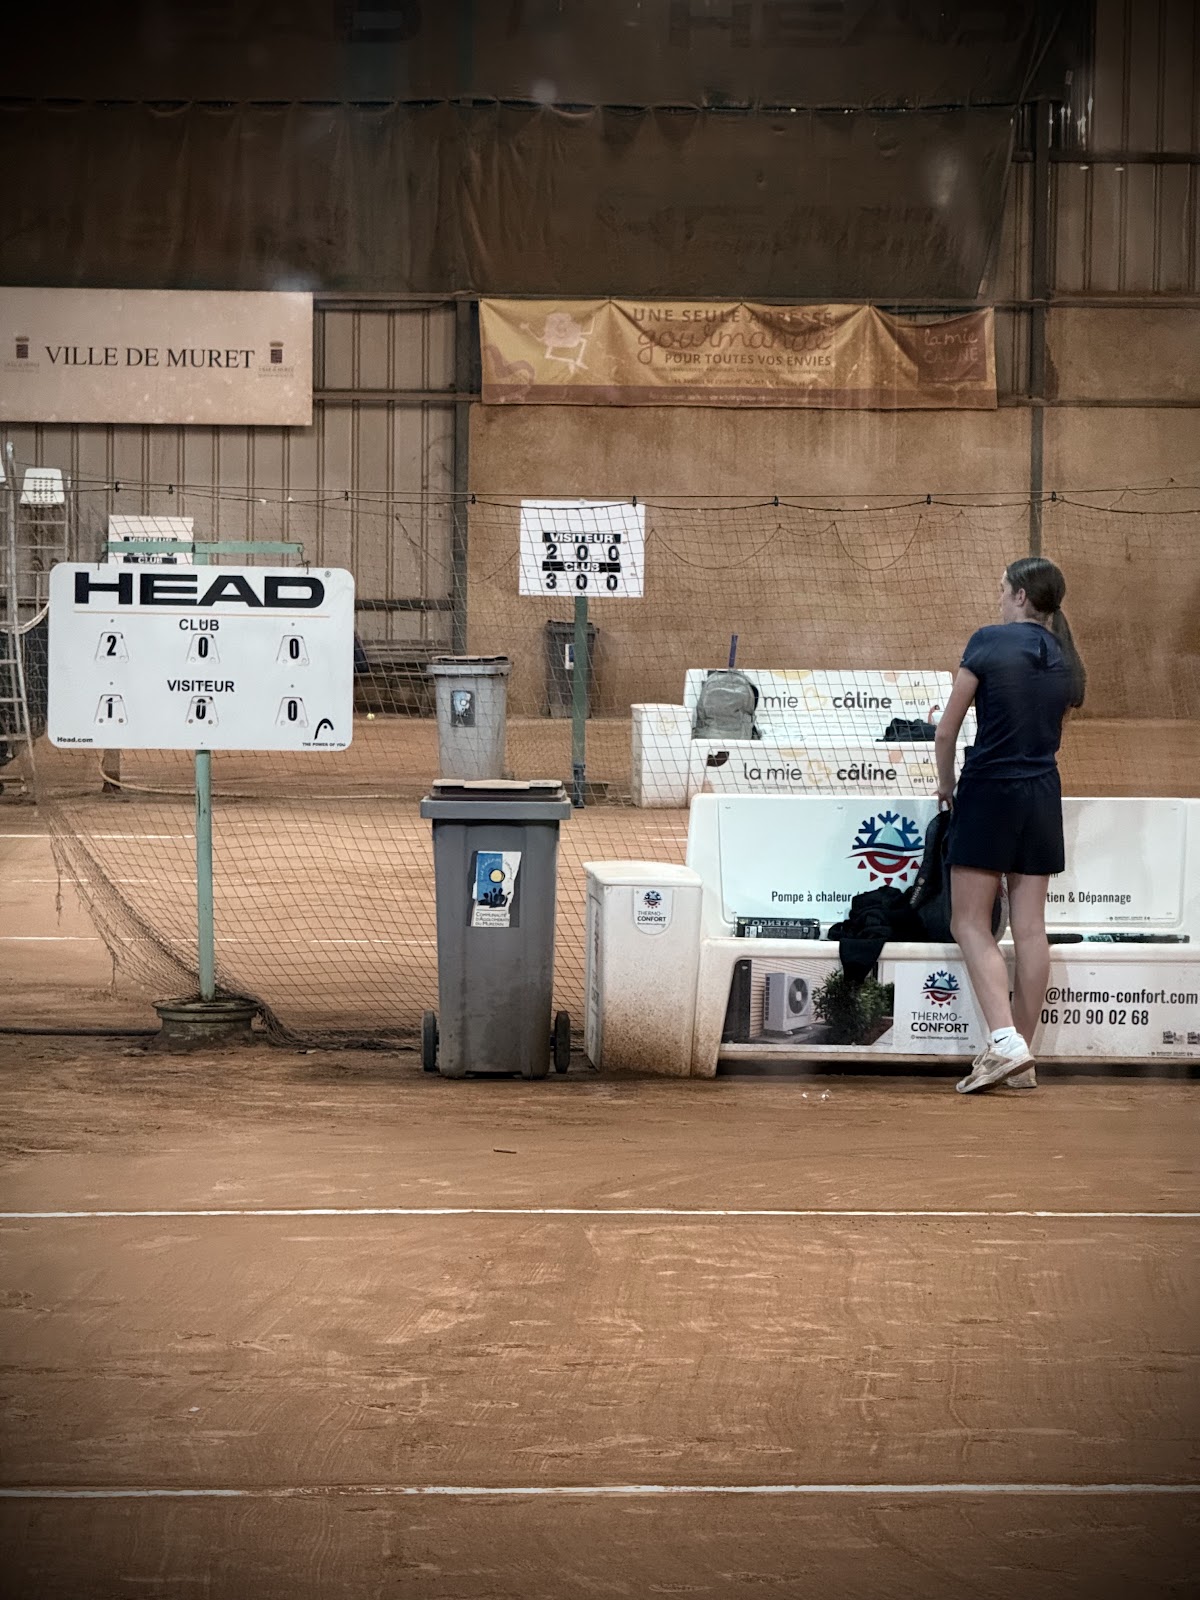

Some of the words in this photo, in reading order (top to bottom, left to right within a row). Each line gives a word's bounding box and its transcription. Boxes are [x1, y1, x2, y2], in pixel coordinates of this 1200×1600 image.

[633, 307, 674, 323] UNE
[682, 309, 740, 324] SEULE
[44, 345, 119, 366] VILLE
[126, 347, 160, 368] DE
[166, 348, 256, 370] MURET
[665, 353, 701, 364] POUR
[704, 353, 754, 365] TOUTES
[757, 354, 783, 366] VOS
[786, 355, 832, 367] ENVIES
[549, 533, 614, 543] VISITEUR
[546, 543, 558, 560] 2
[576, 545, 589, 561] 0
[608, 545, 620, 562] 0
[564, 562, 600, 572] CLUB
[545, 572, 557, 589] 3
[576, 573, 588, 590] 0
[606, 574, 618, 591] 0
[74, 572, 325, 608] HEAD
[178, 618, 220, 632] CLUB
[106, 635, 117, 656] 2
[198, 637, 209, 658] 0
[289, 638, 300, 660] 0
[167, 680, 235, 693] VISITEUR
[764, 692, 799, 709] mie
[832, 692, 892, 709] câline
[287, 700, 298, 722] 0
[744, 763, 761, 780] la
[767, 764, 802, 780] mie
[837, 764, 897, 781] câline
[771, 891, 804, 904] Pompe
[807, 891, 812, 902] à
[816, 891, 851, 902] chaleur
[1068, 892, 1075, 902] &
[1078, 891, 1131, 905] Dépannage
[1045, 988, 1198, 1004] @thermo-confort.com
[911, 1011, 962, 1022] THERMO-
[1041, 1009, 1058, 1024] 06
[1063, 1009, 1080, 1024] 20
[1086, 1009, 1103, 1024] 90
[1109, 1010, 1127, 1025] 02
[1131, 1010, 1149, 1025] 68
[911, 1022, 969, 1033] CONFORT
